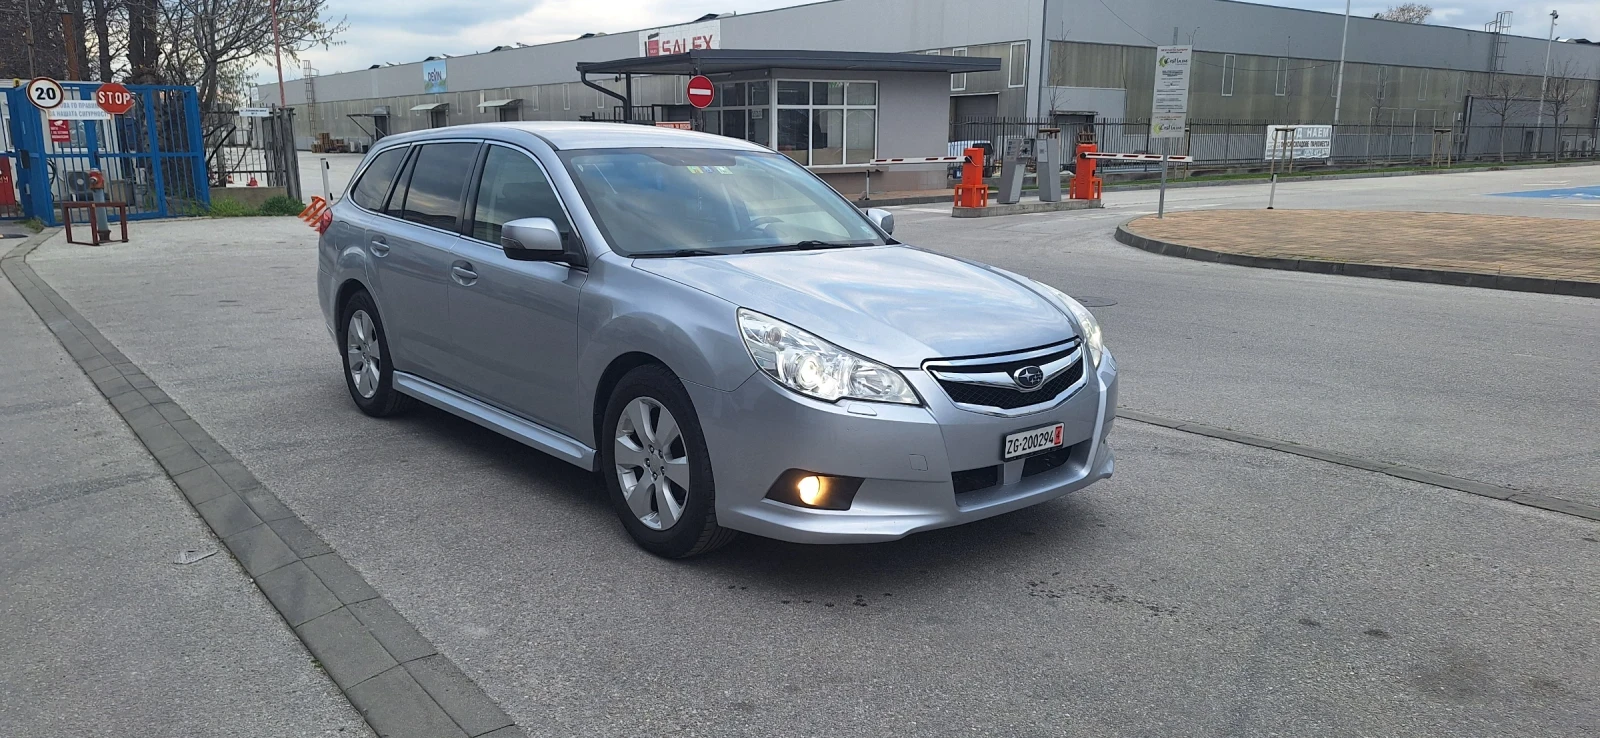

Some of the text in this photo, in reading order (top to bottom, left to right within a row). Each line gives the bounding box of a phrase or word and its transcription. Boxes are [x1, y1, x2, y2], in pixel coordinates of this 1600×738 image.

[35, 87, 56, 100] 20
[98, 91, 131, 105] STOP
[1307, 127, 1330, 138] НАЕМ
